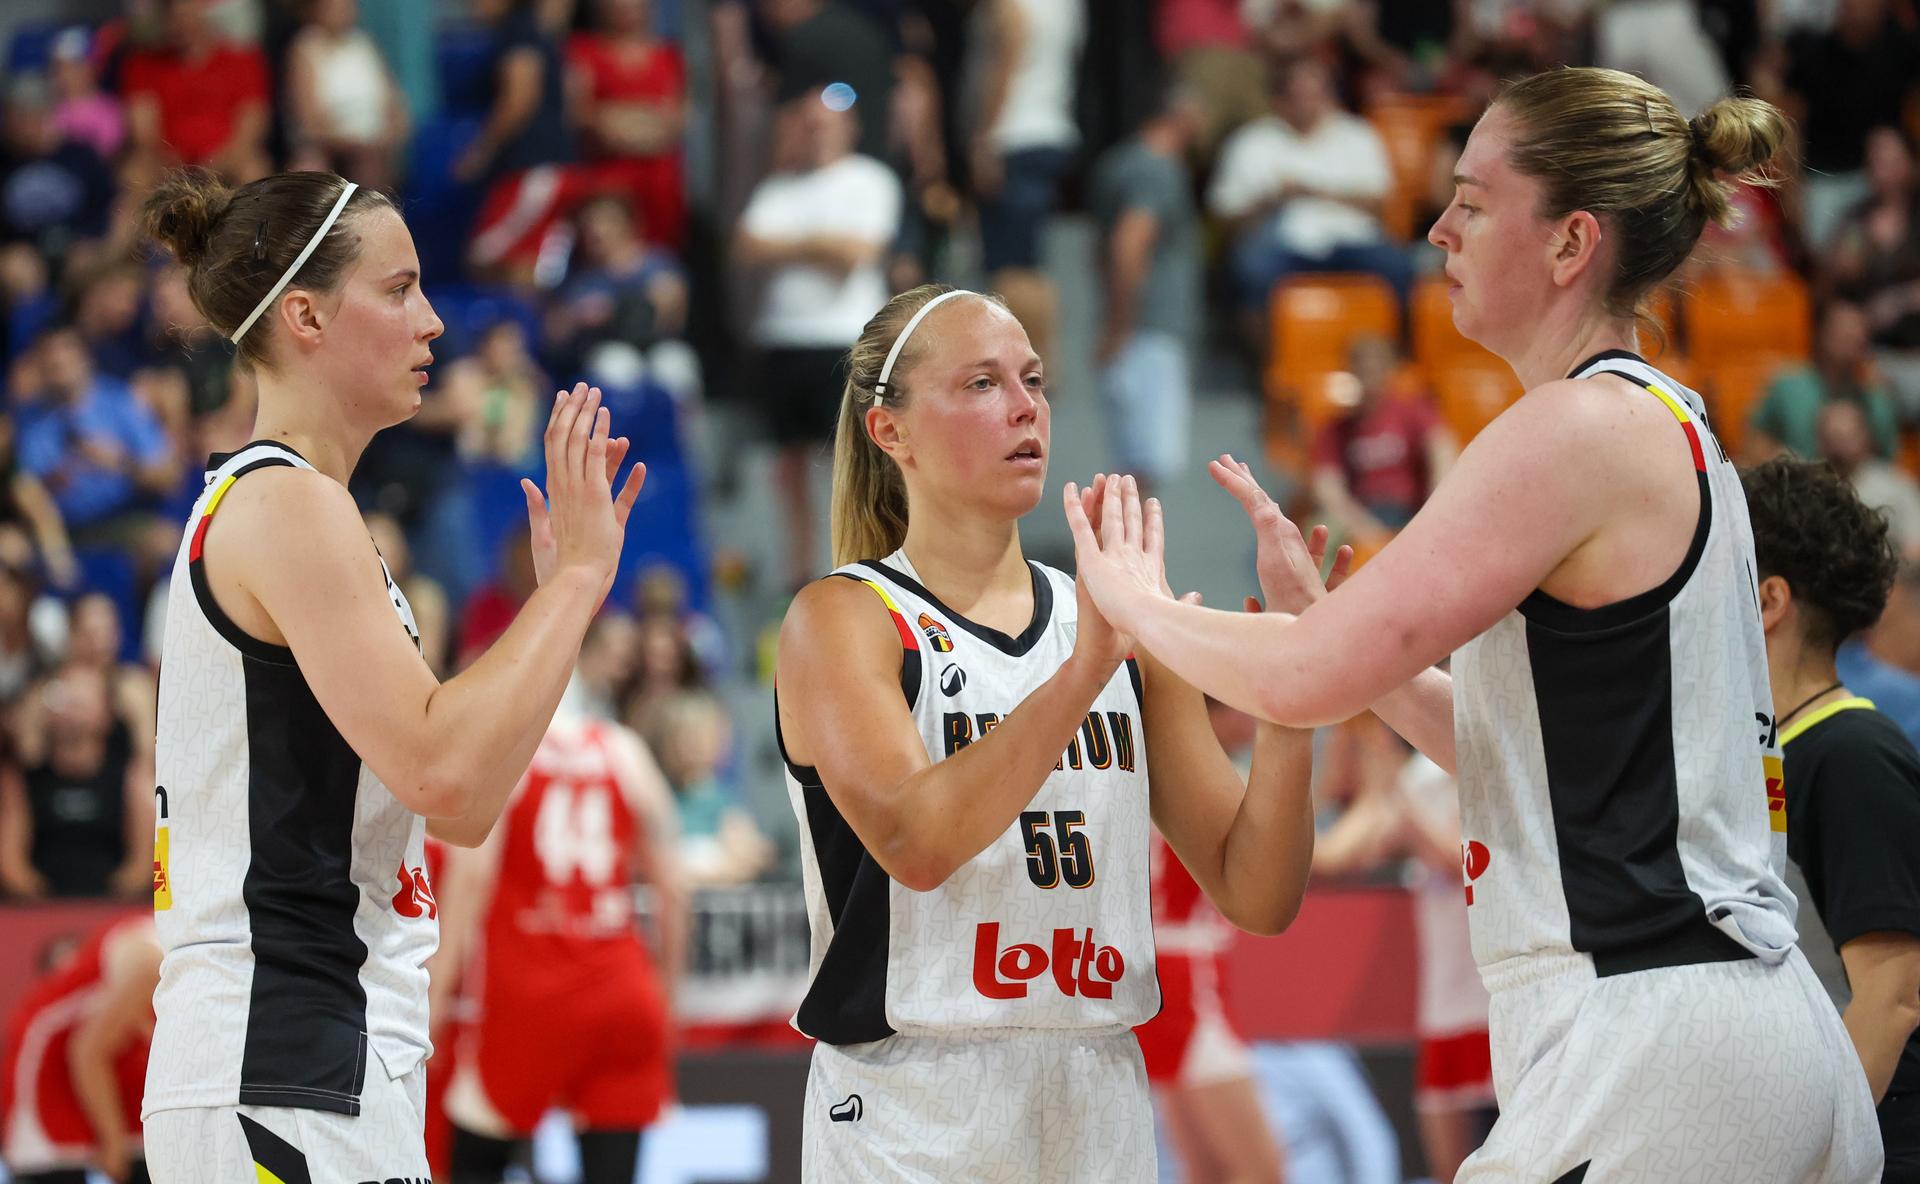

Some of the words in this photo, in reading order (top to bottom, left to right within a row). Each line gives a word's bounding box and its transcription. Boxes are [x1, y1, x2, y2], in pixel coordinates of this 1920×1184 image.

[943, 711, 1135, 773] BIUM
[1020, 811, 1095, 889] 55
[973, 922, 1125, 1000] Lotto
